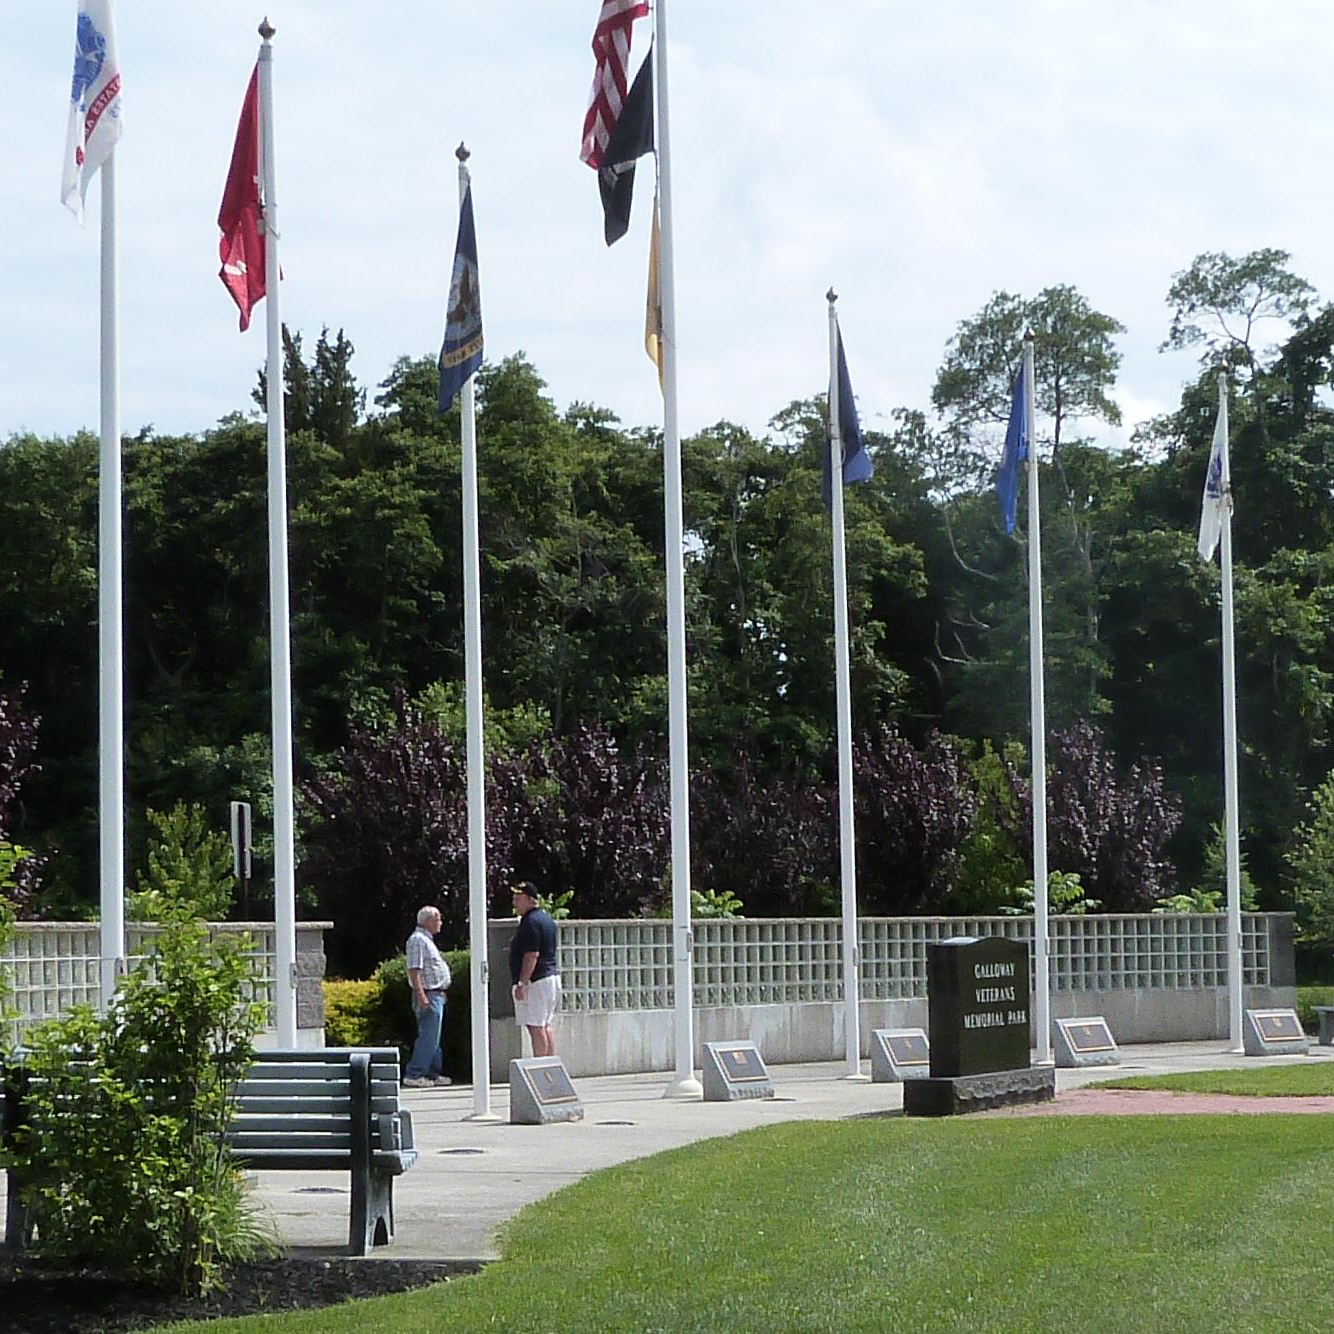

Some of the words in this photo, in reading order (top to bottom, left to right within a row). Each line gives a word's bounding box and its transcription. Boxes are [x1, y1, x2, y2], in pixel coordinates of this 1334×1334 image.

[975, 986, 1015, 1002] VETERANS
[964, 1012, 1005, 1028] MEMORIAL
[1008, 1010, 1027, 1024] PARK
